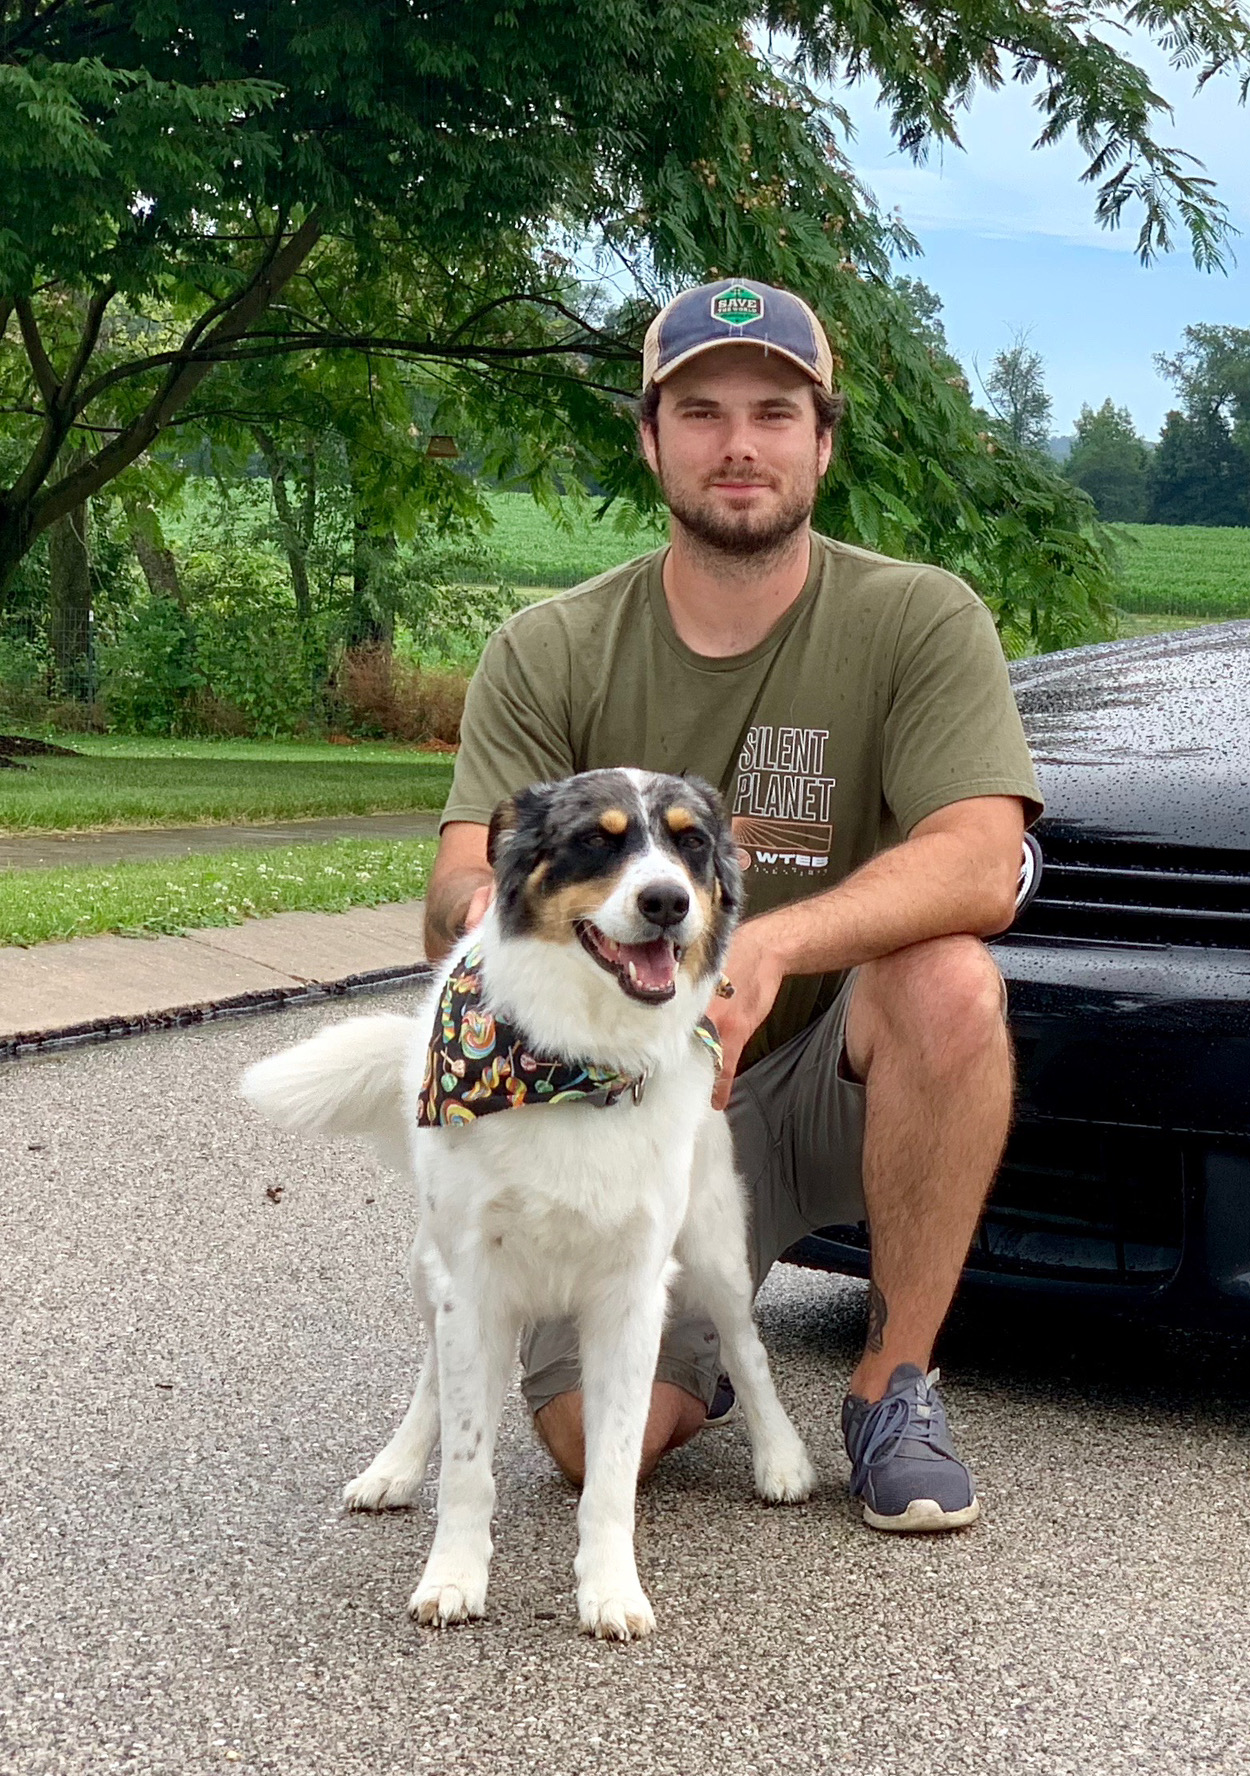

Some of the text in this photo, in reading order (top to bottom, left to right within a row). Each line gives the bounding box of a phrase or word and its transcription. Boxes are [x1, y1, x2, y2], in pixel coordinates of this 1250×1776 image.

[717, 298, 758, 308] SAVE
[739, 726, 829, 775] SILENT
[732, 772, 836, 822] PLANET
